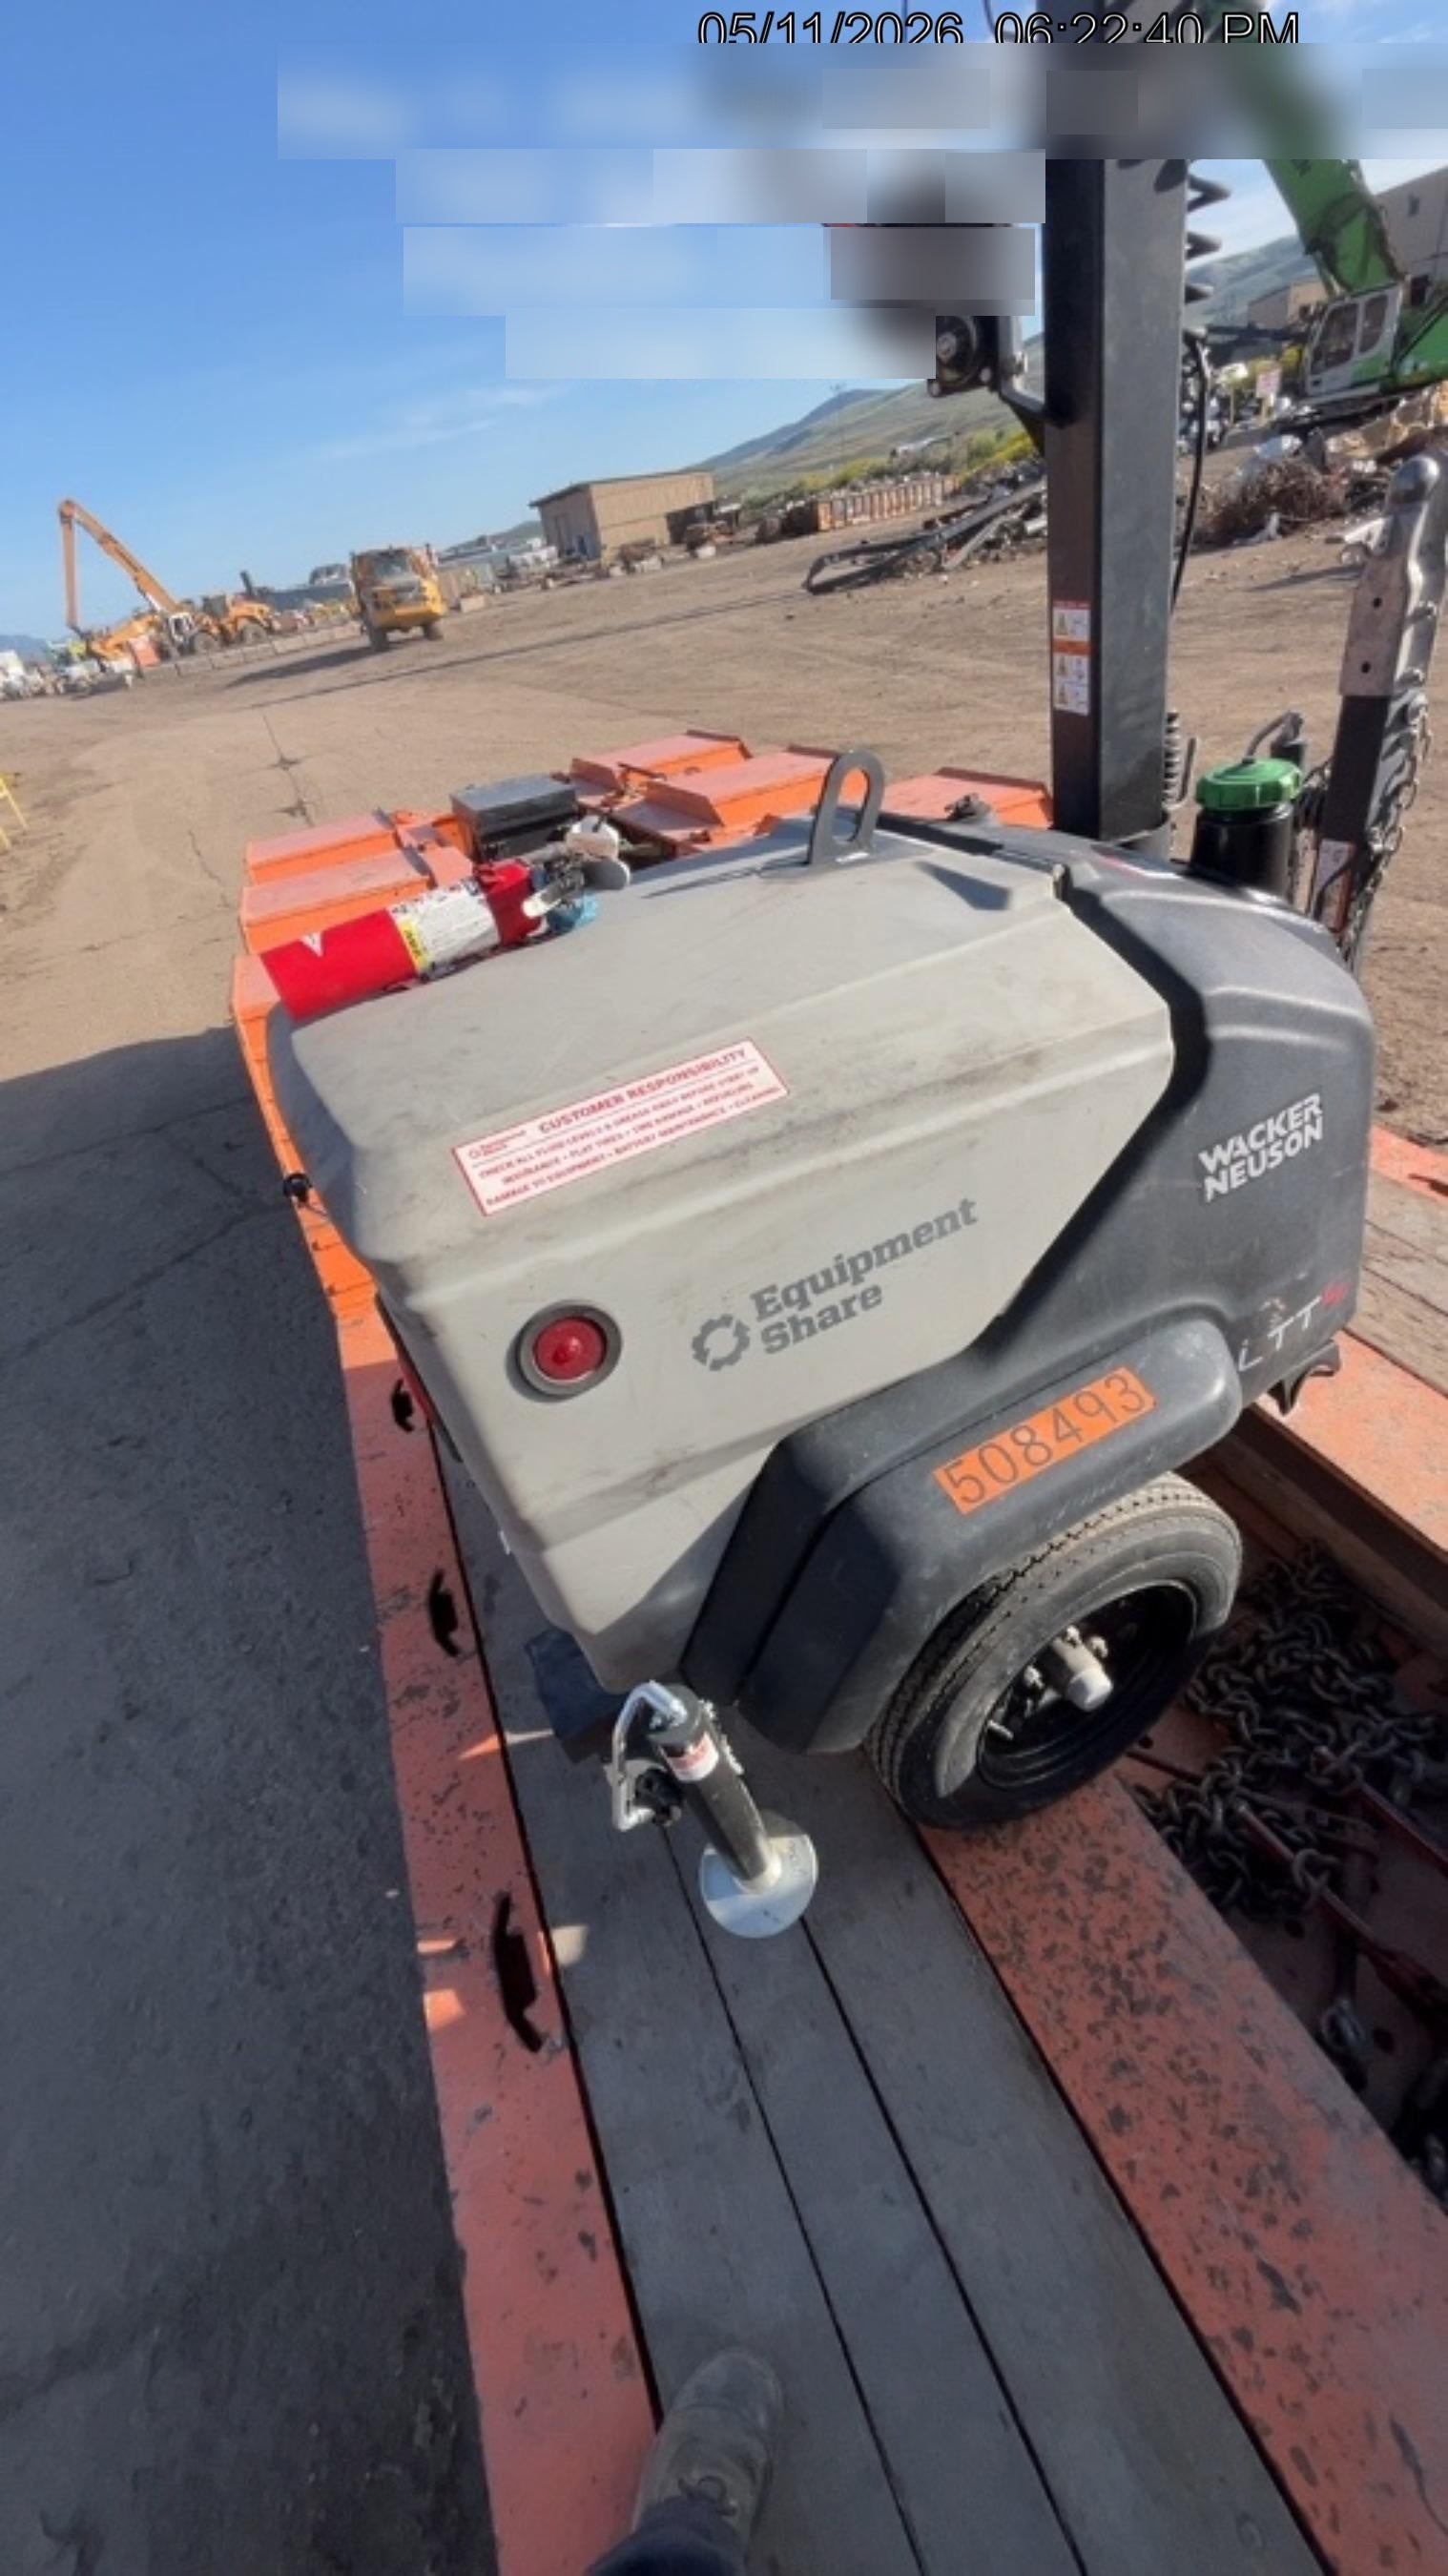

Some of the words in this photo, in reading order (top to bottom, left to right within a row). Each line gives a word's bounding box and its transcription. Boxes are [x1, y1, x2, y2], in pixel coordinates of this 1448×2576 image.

[538, 1092, 624, 1134] CUSTOMER
[627, 1046, 747, 1101] RESPONSIBILITY
[1198, 1092, 1323, 1174] WACKER
[1204, 1115, 1323, 1202] NEUSON
[751, 1197, 979, 1322] Equipment
[761, 1283, 883, 1356] Share
[942, 1374, 1146, 1506] 508493
